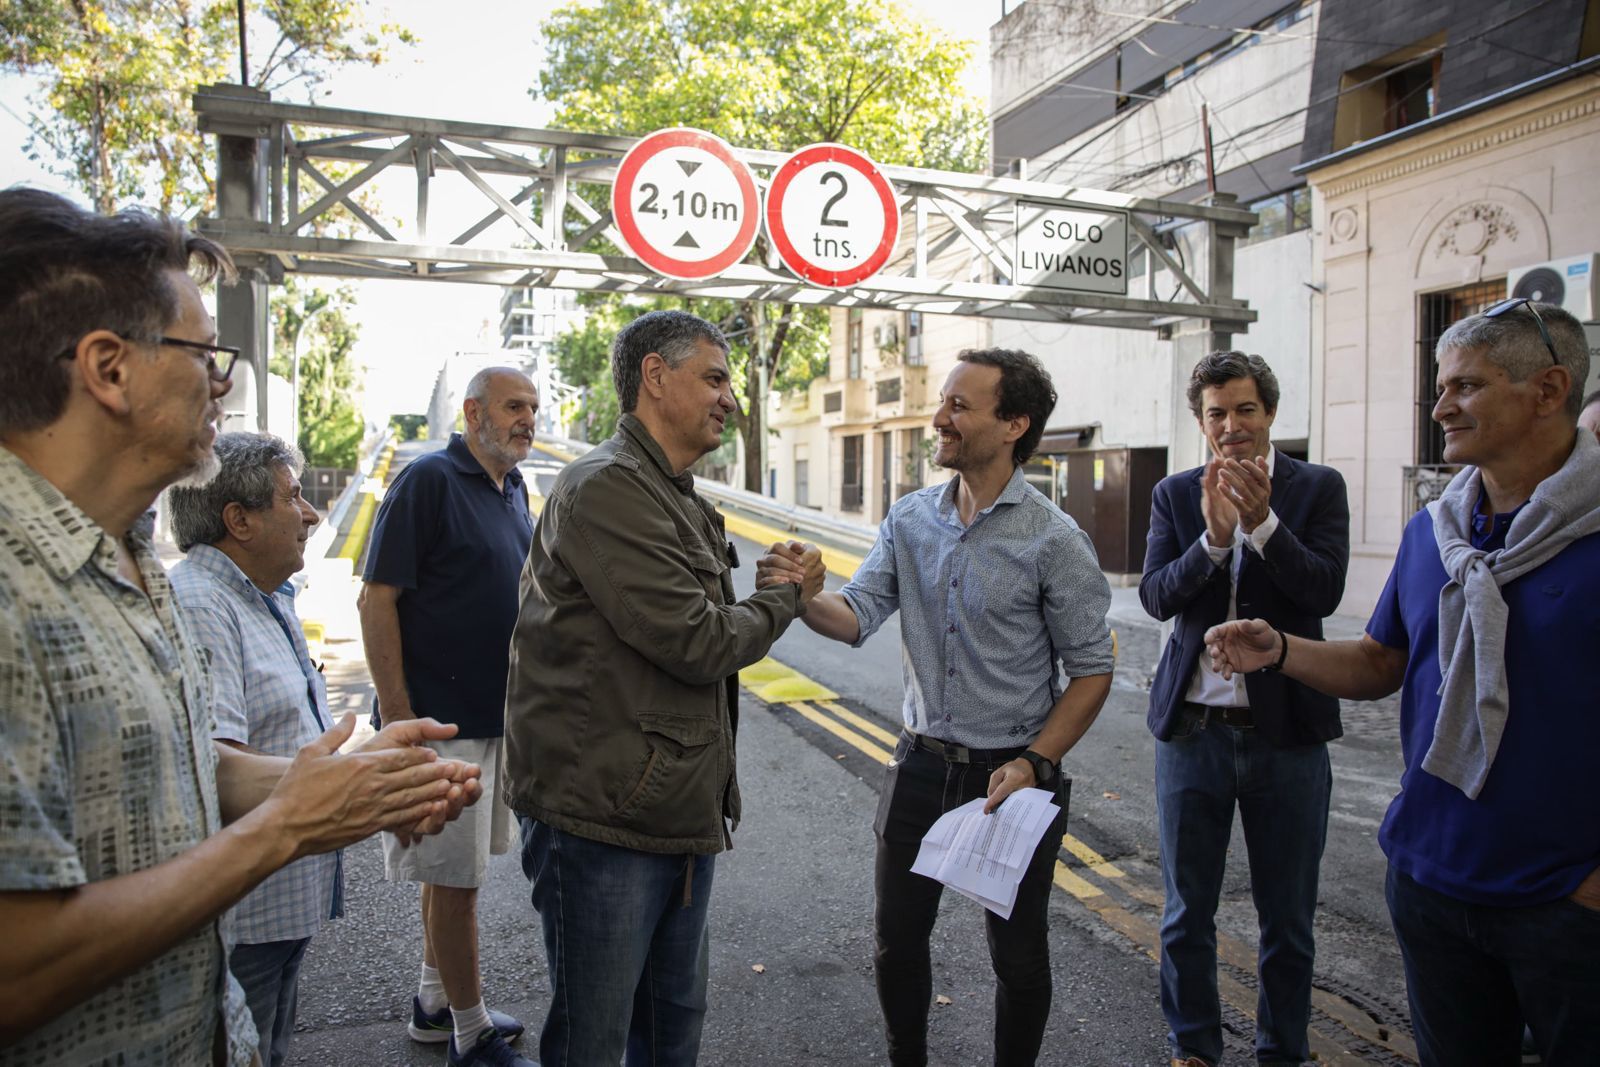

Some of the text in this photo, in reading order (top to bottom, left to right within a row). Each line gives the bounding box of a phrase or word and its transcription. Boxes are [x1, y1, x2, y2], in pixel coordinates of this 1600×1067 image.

[819, 170, 849, 228] 2
[812, 231, 857, 260] tns.
[1042, 219, 1103, 244] SOLO
[1021, 250, 1122, 278] LIVIANOS
